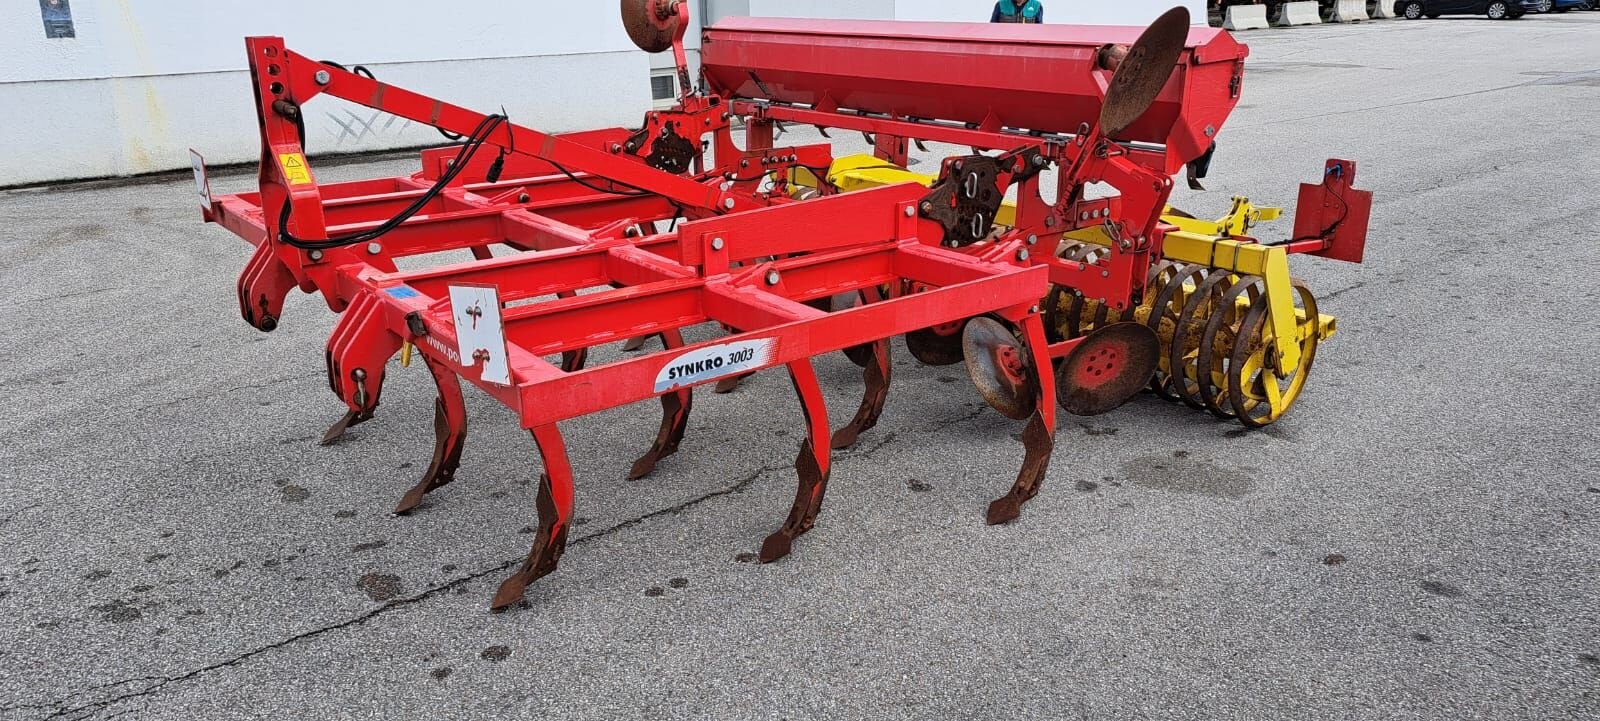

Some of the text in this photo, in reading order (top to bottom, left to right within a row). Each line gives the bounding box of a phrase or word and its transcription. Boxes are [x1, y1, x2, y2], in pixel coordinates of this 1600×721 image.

[425, 334, 460, 363] www.po
[668, 348, 754, 380] SYNKRO 3003
